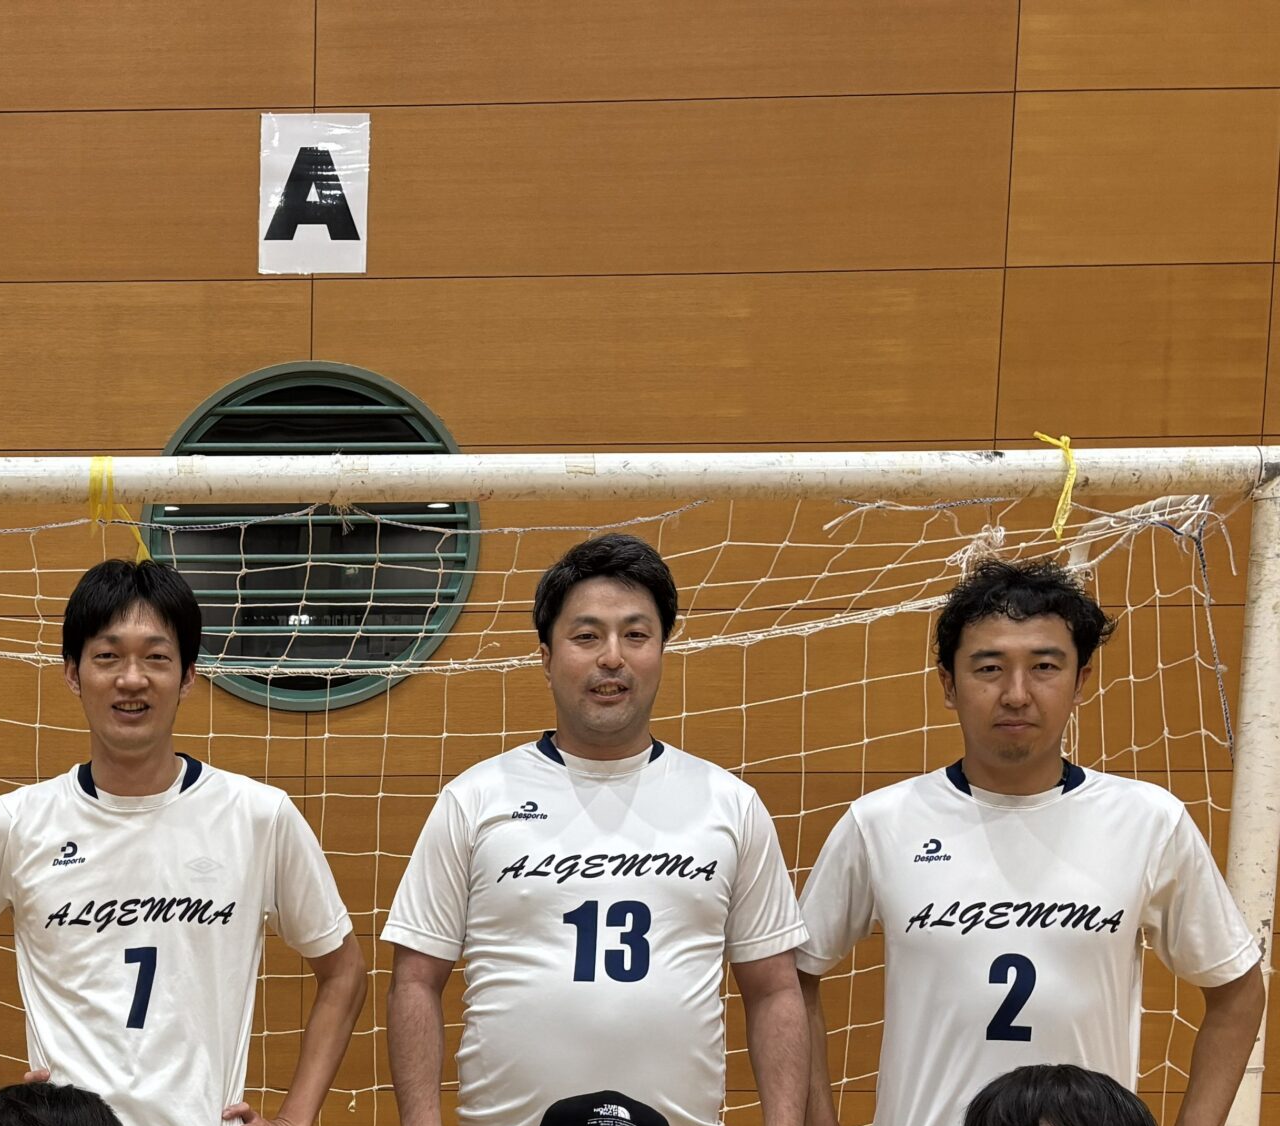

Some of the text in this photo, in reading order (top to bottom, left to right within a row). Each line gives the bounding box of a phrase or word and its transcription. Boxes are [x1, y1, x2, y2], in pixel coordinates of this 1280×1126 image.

[264, 147, 360, 241] A
[512, 811, 548, 821] Desporte
[52, 856, 86, 867] Desporte
[497, 852, 718, 884] ALGEMMA
[914, 853, 951, 864] Desporte
[45, 896, 237, 933] ALGEMMA
[905, 901, 1125, 935] ALGEMMA
[563, 900, 652, 983] 13
[124, 946, 158, 1029] 7
[985, 953, 1037, 1043] 2
